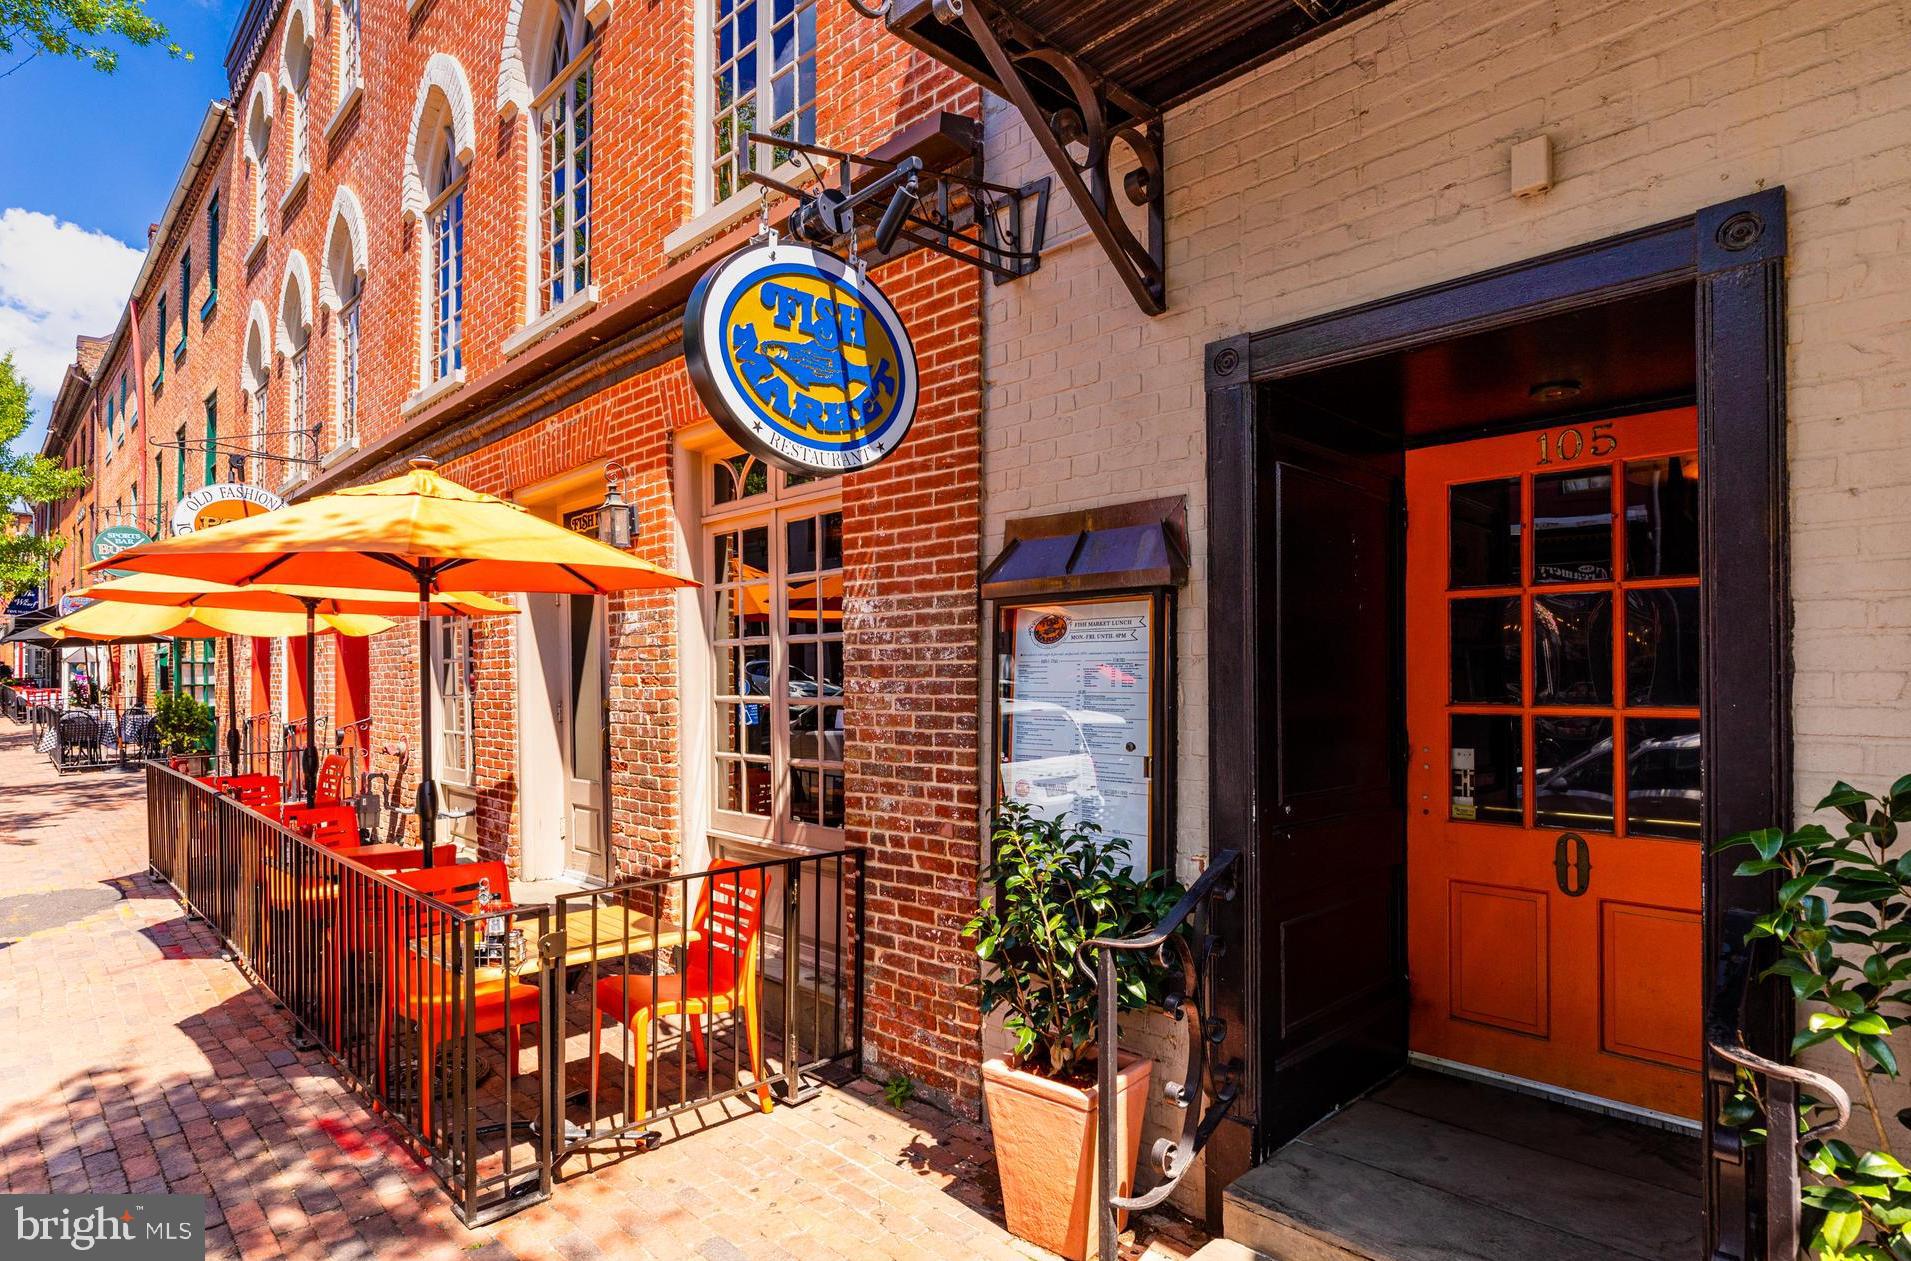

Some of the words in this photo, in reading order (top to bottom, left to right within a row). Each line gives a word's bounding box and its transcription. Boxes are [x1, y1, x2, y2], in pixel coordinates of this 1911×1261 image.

[760, 281, 868, 350] FISH
[732, 322, 896, 435] MARKET
[769, 432, 873, 467] RESTAURANT
[1535, 422, 1618, 466] 105
[186, 491, 213, 512] OLD
[571, 513, 594, 532] FISH
